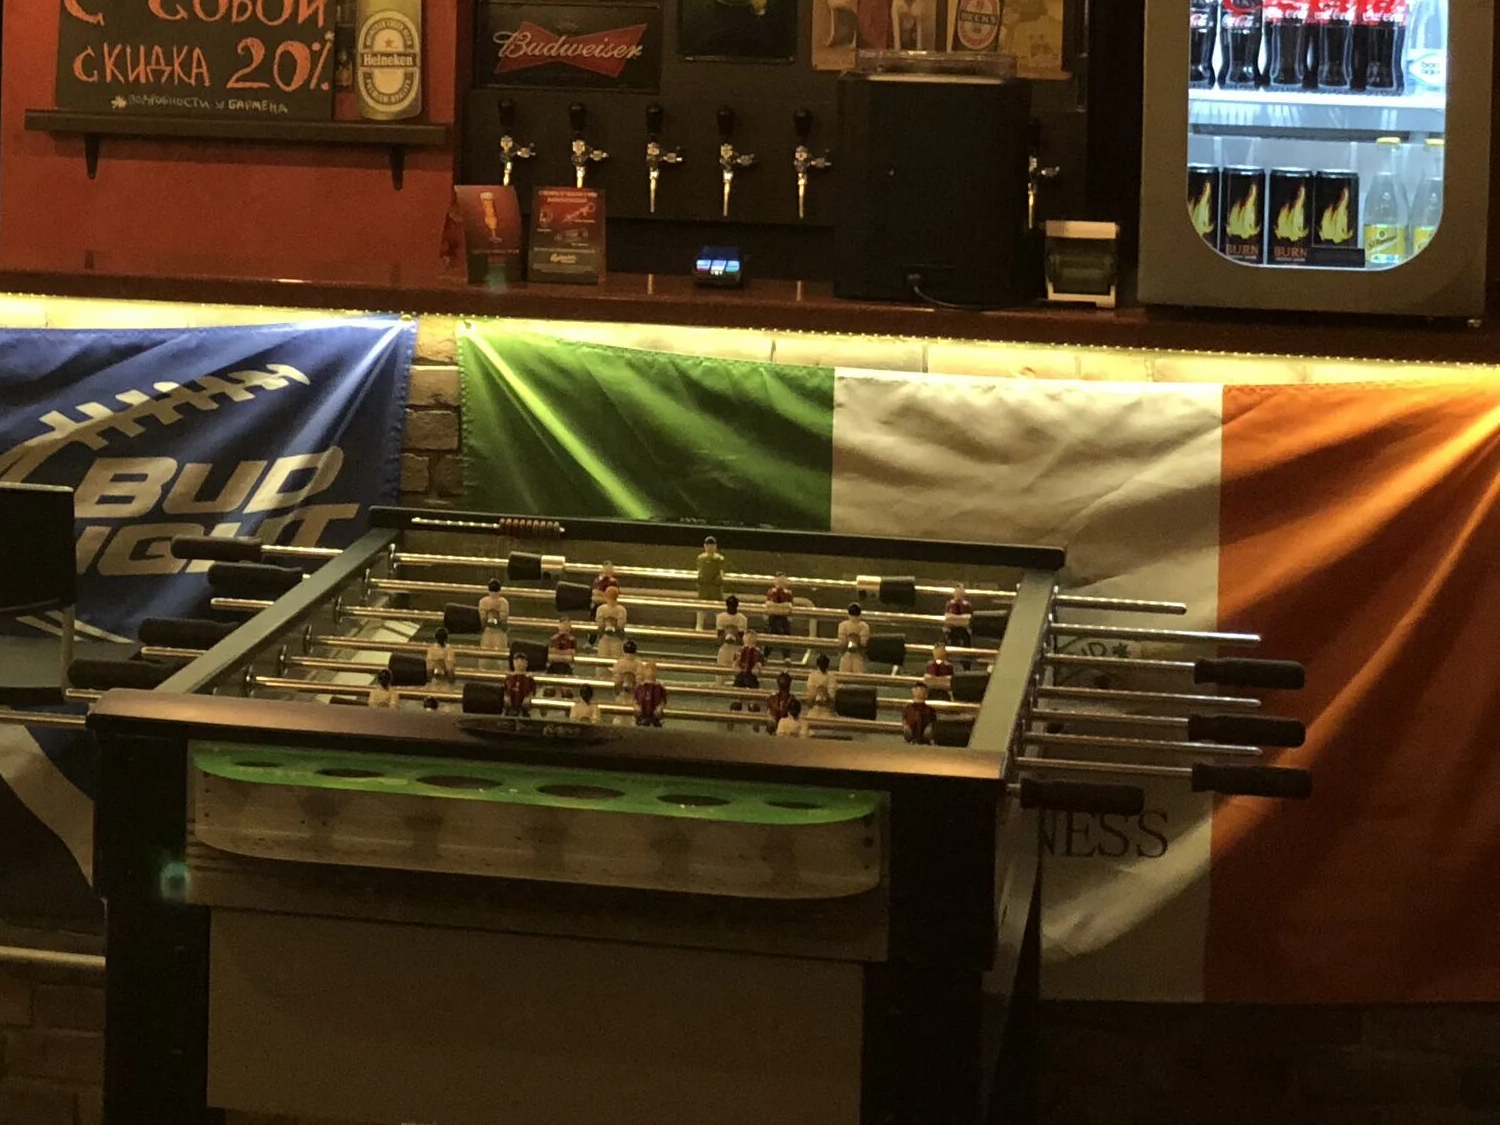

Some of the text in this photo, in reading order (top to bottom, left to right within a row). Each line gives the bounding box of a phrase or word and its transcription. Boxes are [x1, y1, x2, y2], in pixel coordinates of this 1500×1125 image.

[363, 53, 413, 66] Heineken
[493, 30, 644, 60] Budweiser
[73, 42, 211, 88] СКИДКА
[1225, 244, 1258, 256] BURN
[1274, 245, 1308, 257] BURN
[74, 445, 344, 518] BUD
[76, 502, 360, 576] IGHT
